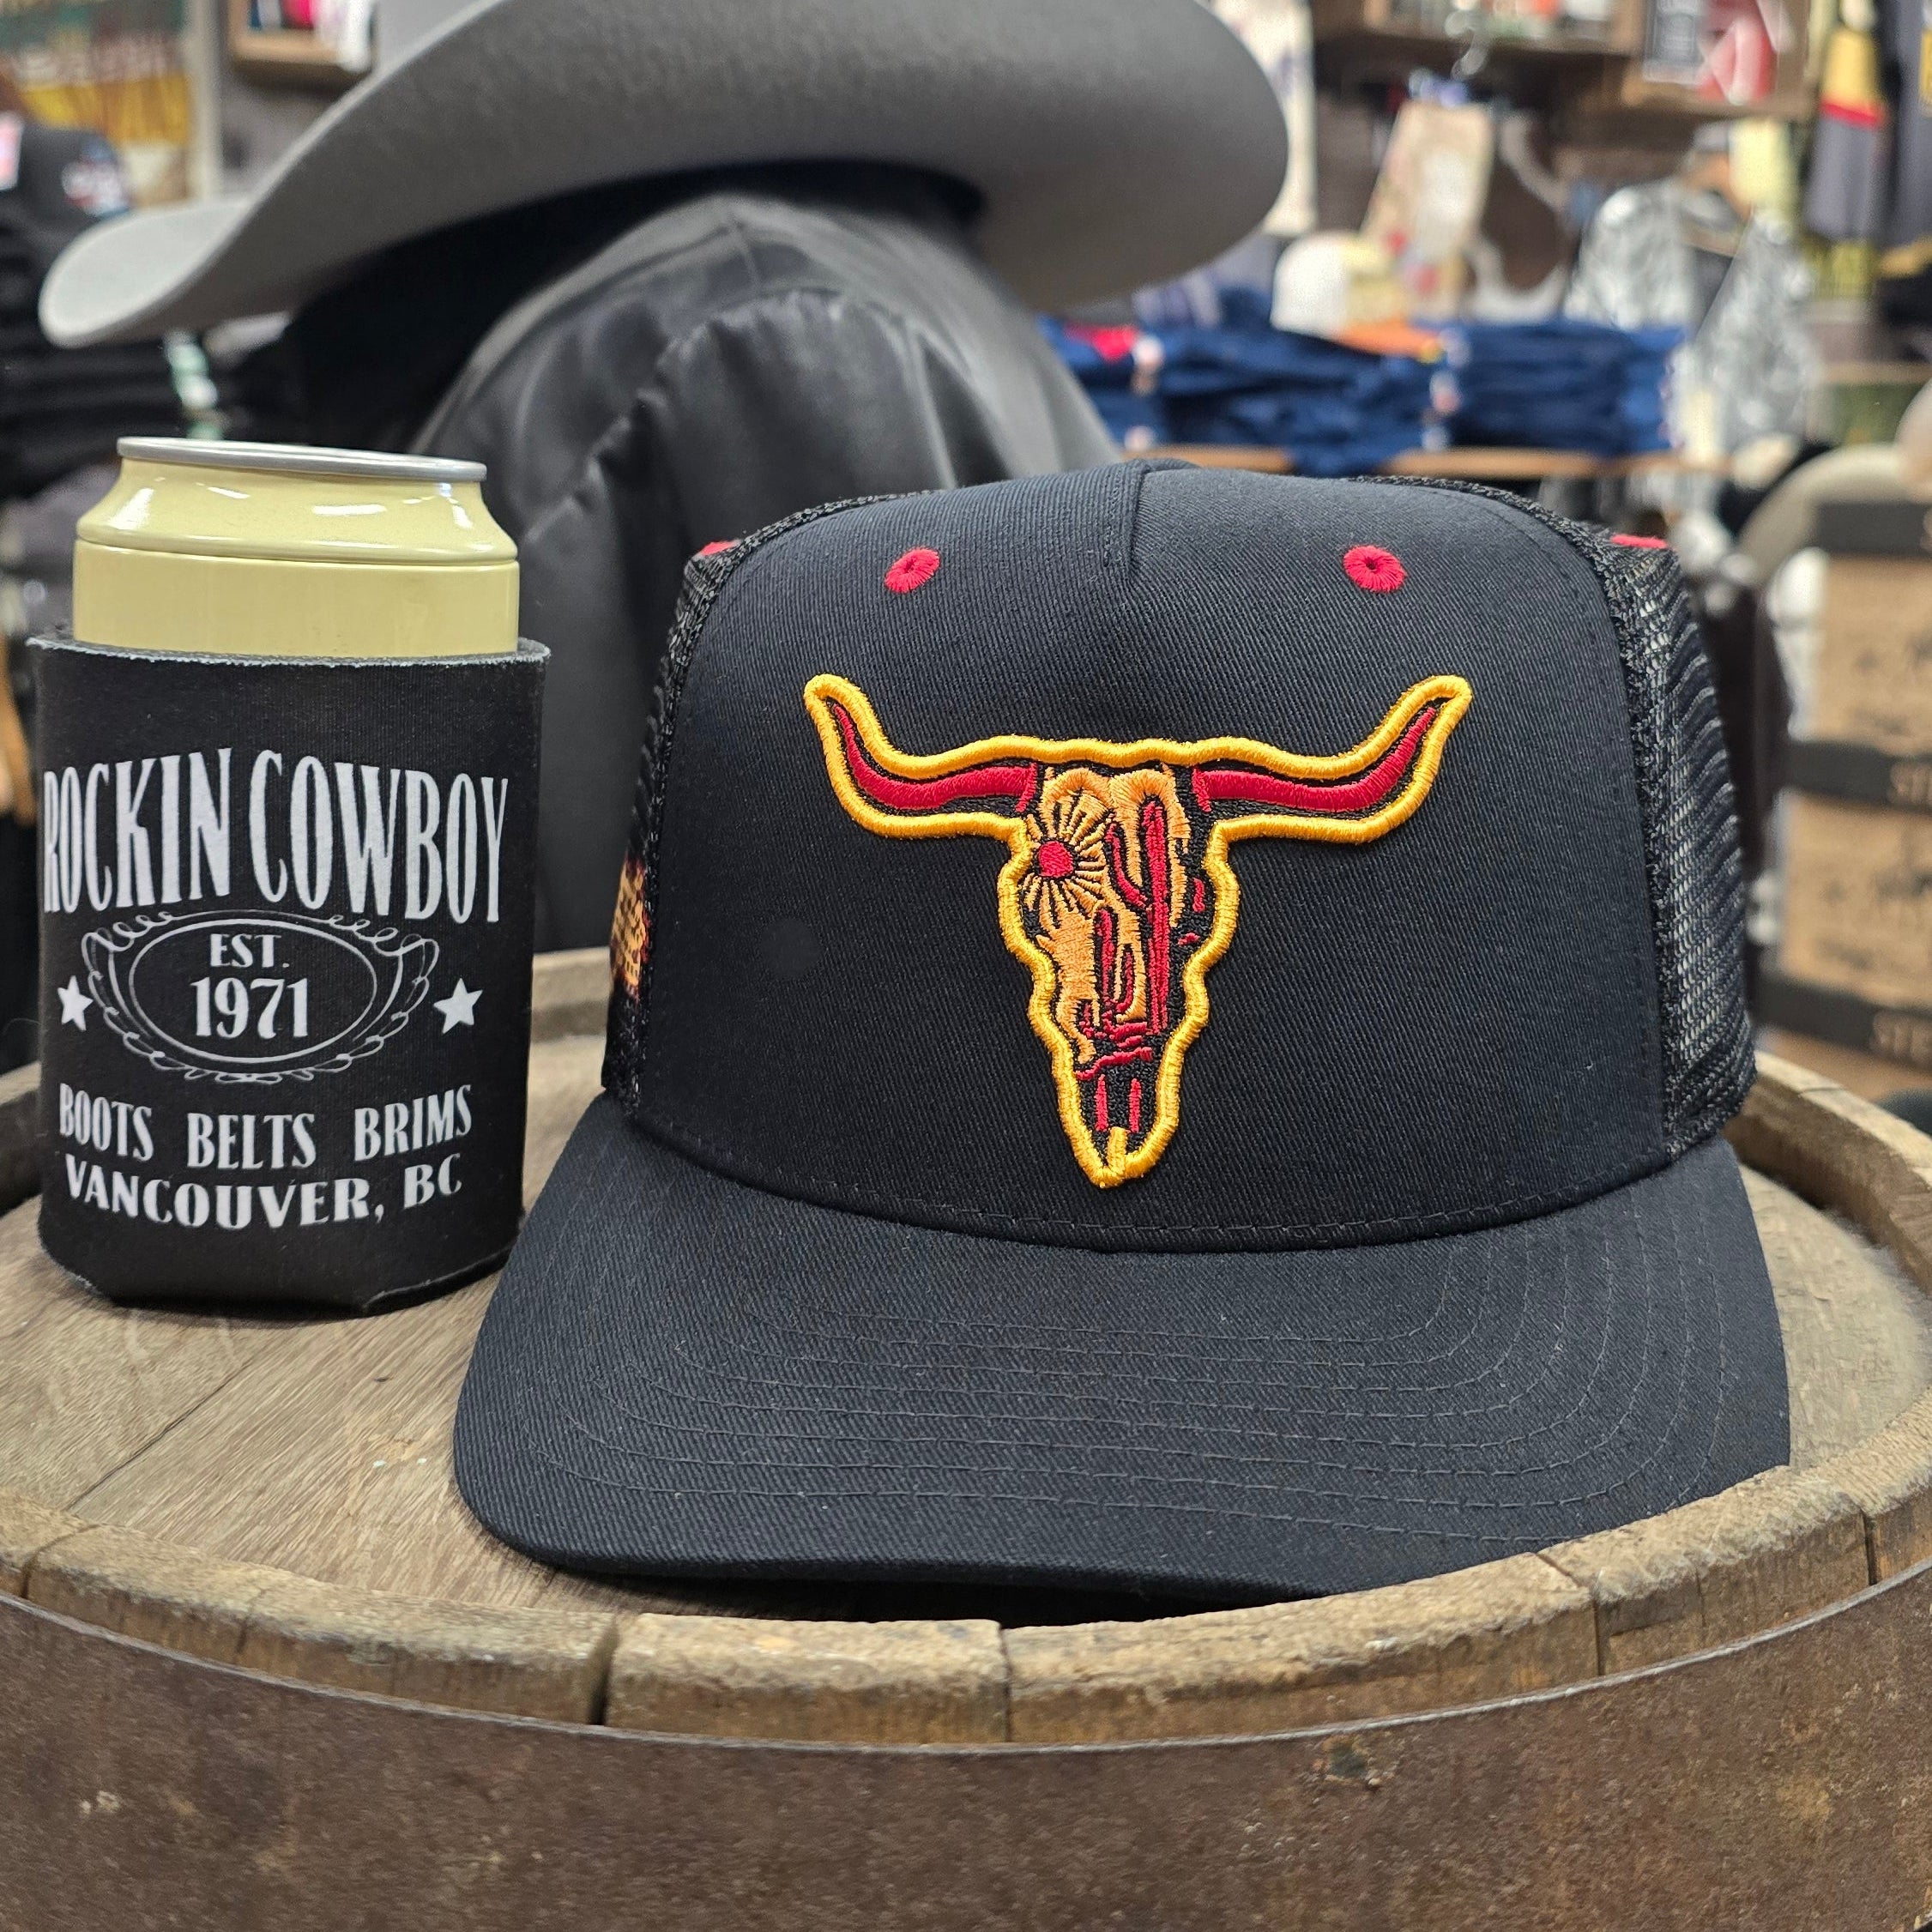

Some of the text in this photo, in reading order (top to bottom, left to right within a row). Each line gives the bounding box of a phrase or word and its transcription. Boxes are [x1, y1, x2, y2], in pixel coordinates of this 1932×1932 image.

[43, 746, 510, 925] ROCKIN COWBOY
[209, 933, 290, 969] EST.
[190, 976, 309, 1040] 1971
[58, 1082, 473, 1170] BOOTS BELTS BRIMS
[64, 1152, 463, 1230] VANCOUVER, BC
